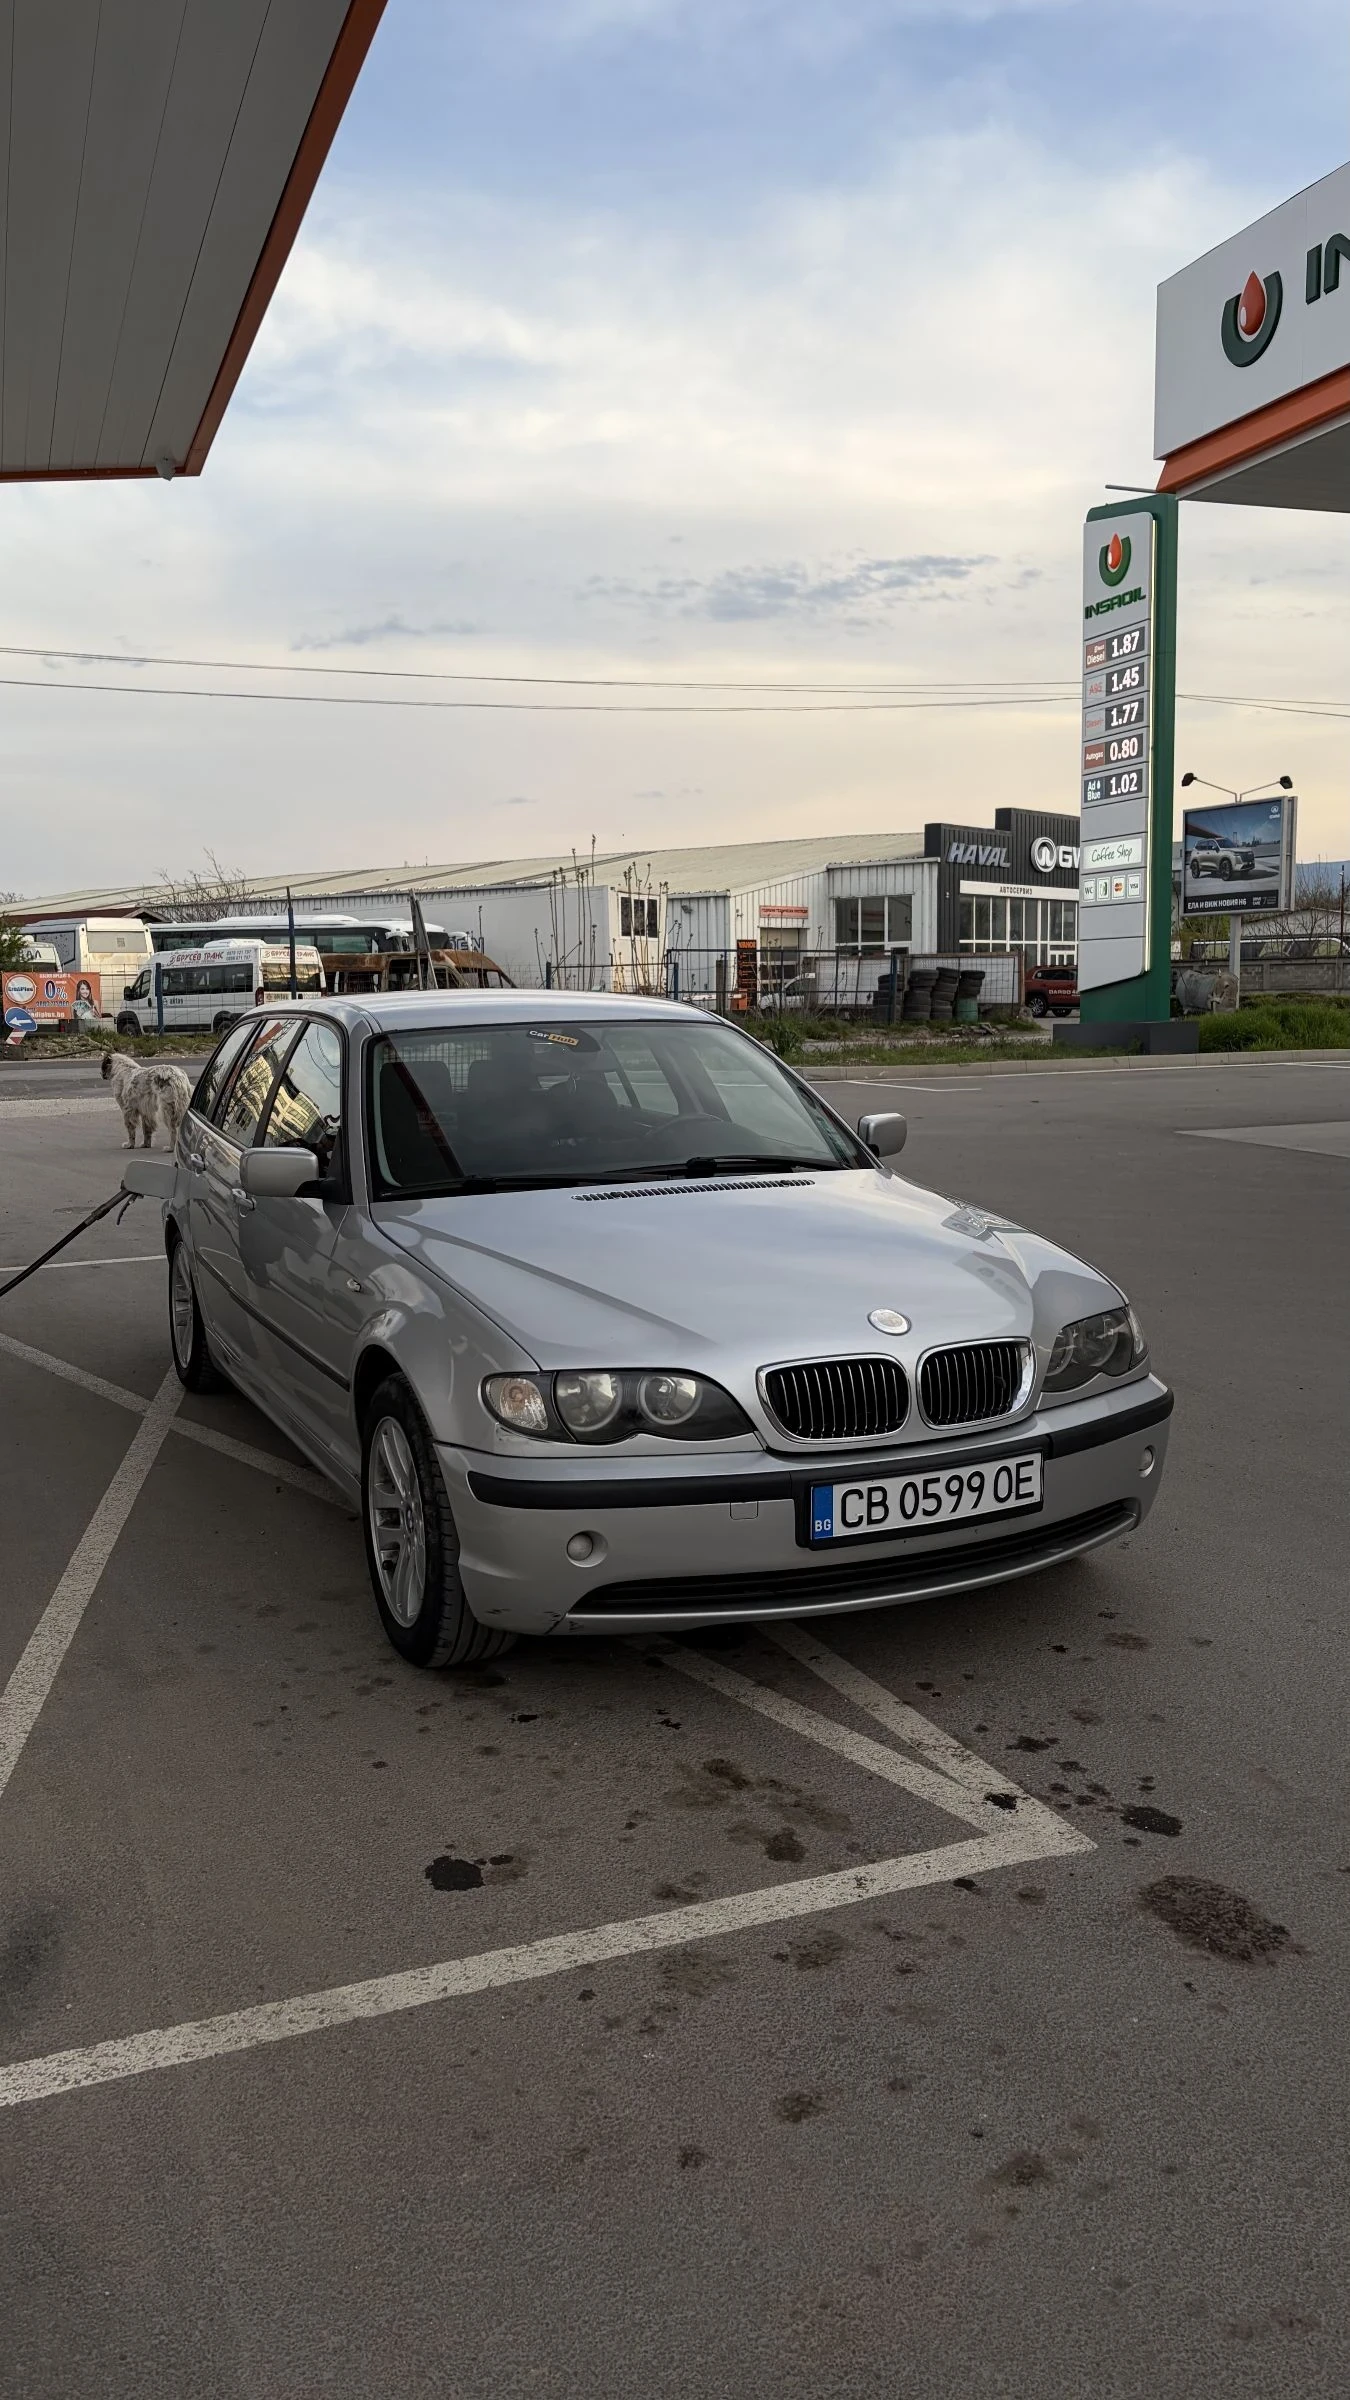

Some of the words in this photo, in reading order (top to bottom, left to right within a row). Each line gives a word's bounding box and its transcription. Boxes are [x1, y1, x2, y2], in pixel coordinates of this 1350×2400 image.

[1085, 587, 1146, 619] INSAOIL
[1111, 631, 1140, 658] 1.87
[1086, 651, 1105, 665] Diesel
[1111, 666, 1140, 692] 1.45
[1110, 702, 1139, 727] 1.77
[1109, 737, 1138, 761] 0.80
[1087, 790, 1101, 801] Blue
[1088, 781, 1096, 790] Ad
[1109, 773, 1138, 795] 1.02
[946, 842, 1011, 868] HAVAL
[1091, 847, 1115, 862] Coffee
[1117, 844, 1133, 862] Shop
[1085, 886, 1094, 895] WC
[1187, 902, 1199, 910] ЕЛА
[815, 1519, 831, 1532] BG
[841, 1486, 890, 1528] CB
[900, 1471, 985, 1520] 0599
[993, 1460, 1035, 1504] OE
